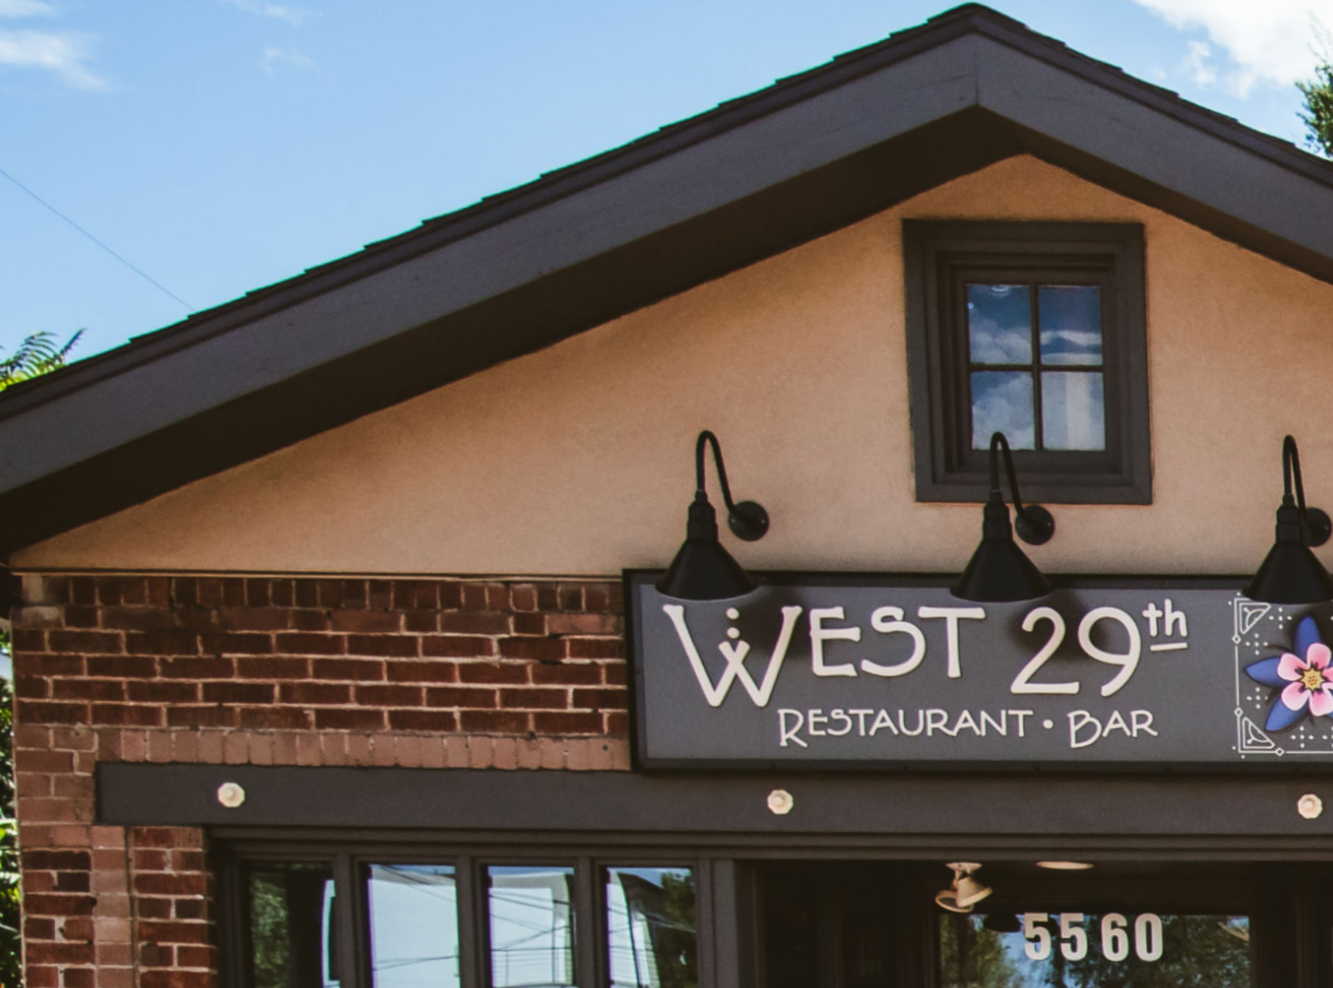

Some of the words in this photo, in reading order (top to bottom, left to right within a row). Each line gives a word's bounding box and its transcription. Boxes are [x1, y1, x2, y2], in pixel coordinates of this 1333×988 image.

[662, 604, 987, 707] WEST
[1010, 599, 1189, 697] 29th
[777, 708, 1034, 748] RESTAURANT
[1067, 710, 1159, 748] BAR
[1023, 912, 1164, 962] 5560
